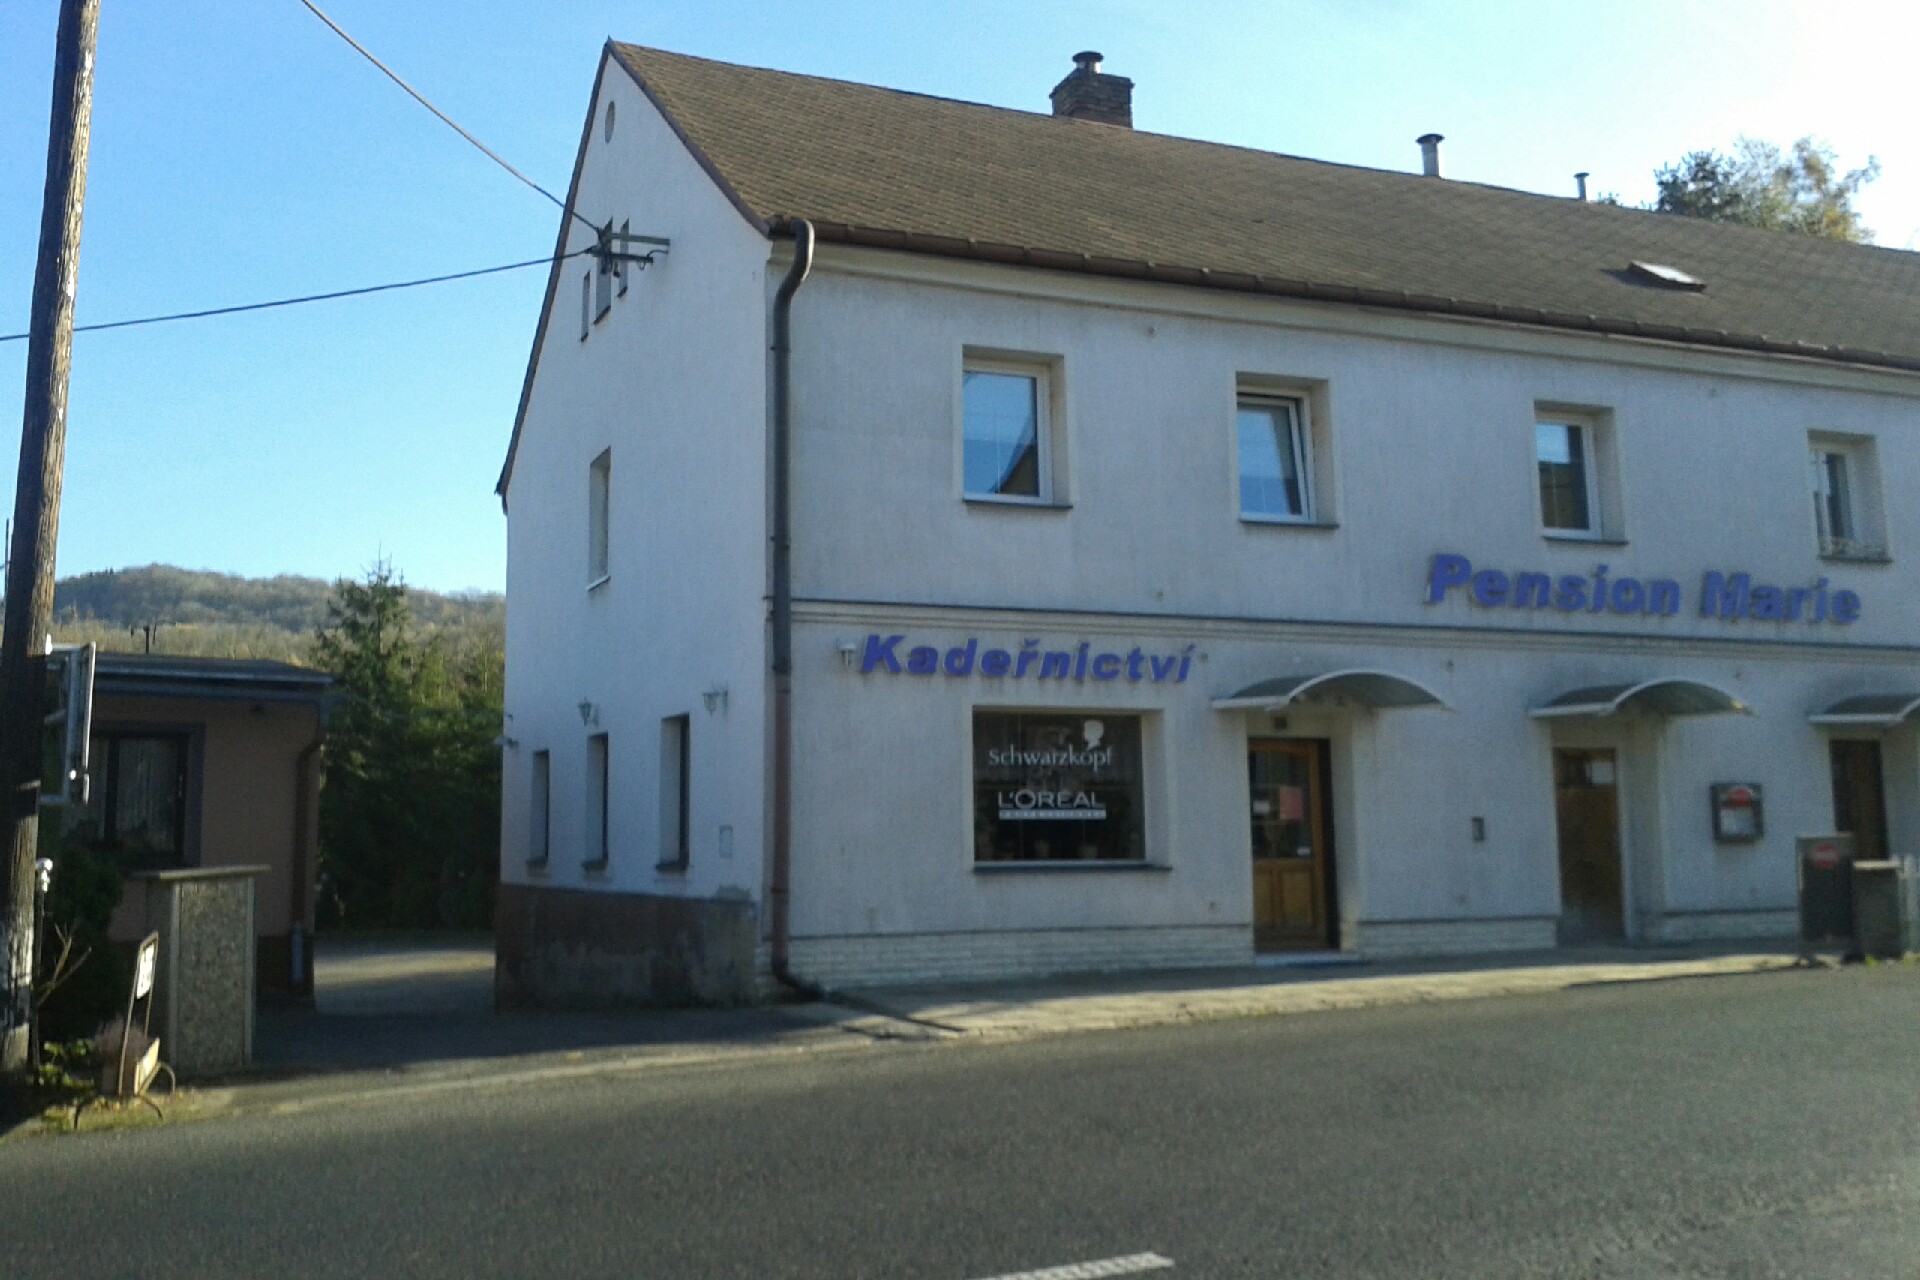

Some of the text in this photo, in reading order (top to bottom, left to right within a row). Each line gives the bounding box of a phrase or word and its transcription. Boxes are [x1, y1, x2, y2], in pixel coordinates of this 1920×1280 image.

[1427, 553, 1863, 624] Pension Marie
[861, 634, 1195, 682] Kadeřnictví
[988, 744, 1112, 772] Schwarzkopf
